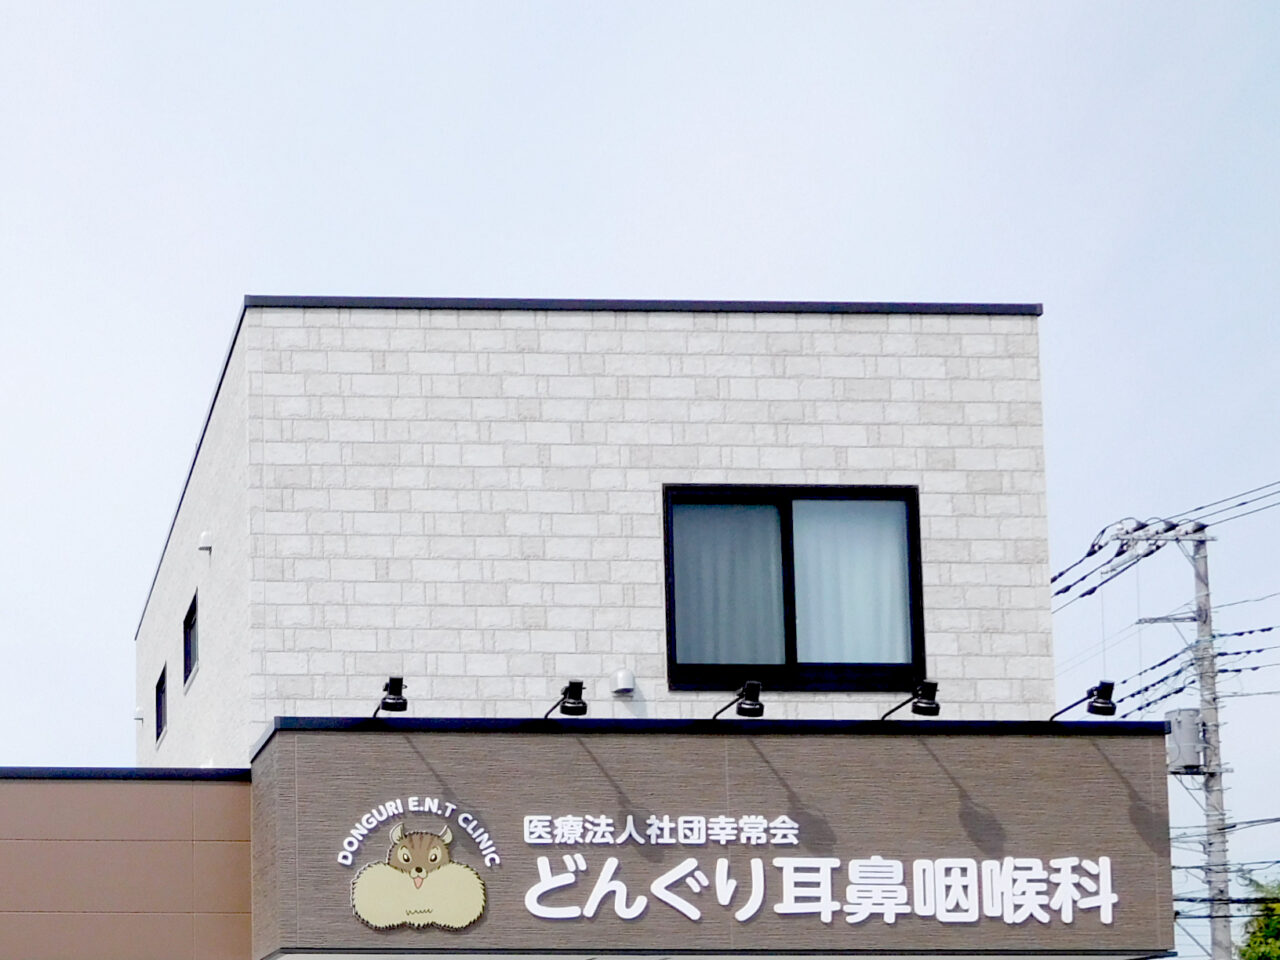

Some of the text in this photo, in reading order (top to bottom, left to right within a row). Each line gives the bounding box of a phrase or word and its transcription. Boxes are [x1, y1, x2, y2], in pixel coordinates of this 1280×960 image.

[337, 796, 501, 867] DONGURI E.N.T CLINIC
[523, 814, 799, 845] 医療法人社団幸常会
[523, 853, 1118, 924] どんぐり耳鼻咽喉科
